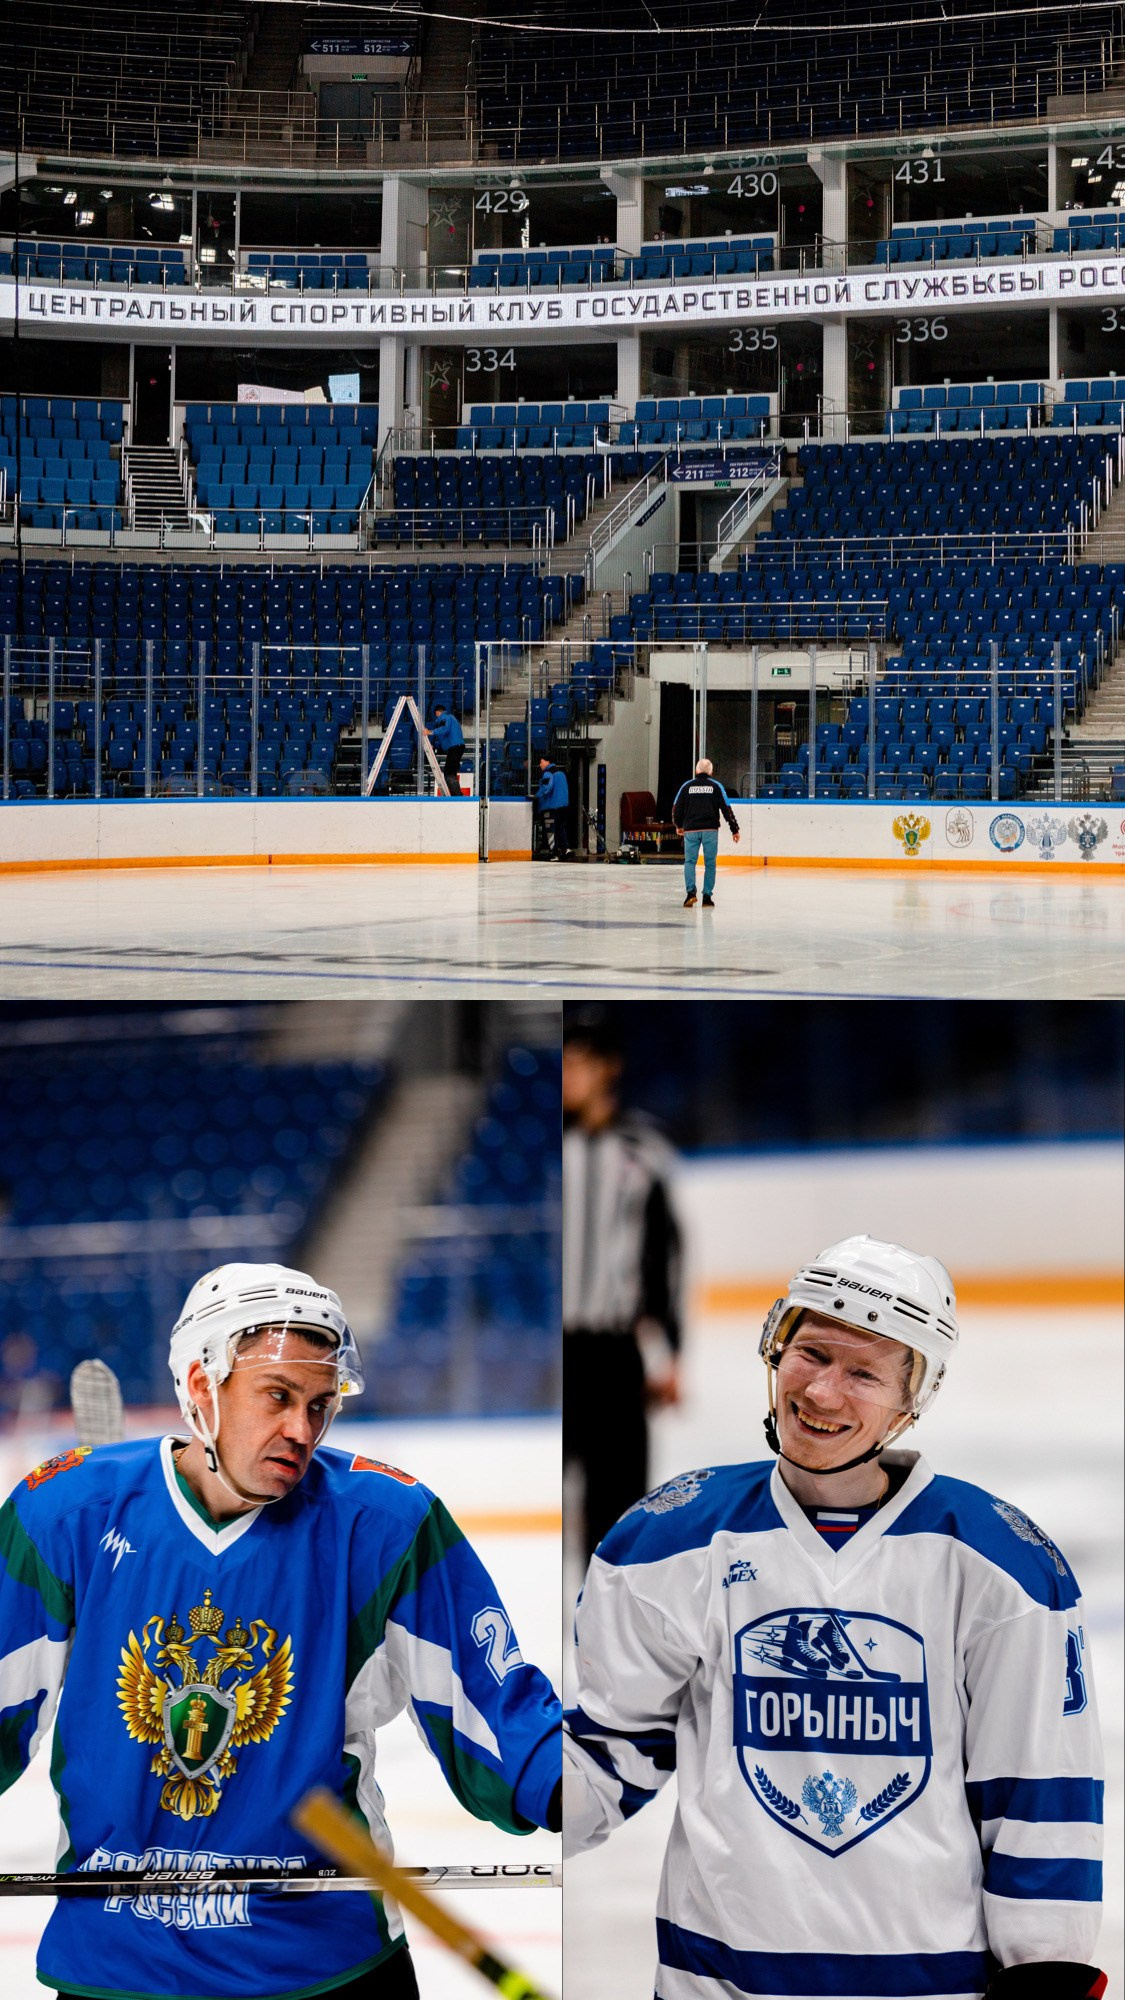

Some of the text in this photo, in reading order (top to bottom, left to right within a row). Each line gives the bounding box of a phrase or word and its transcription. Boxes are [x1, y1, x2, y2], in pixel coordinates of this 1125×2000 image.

[322, 44, 340, 53] 511
[364, 44, 382, 53] 512
[895, 158, 946, 184] 431
[727, 172, 778, 198] 430
[475, 190, 527, 213] 429
[29, 292, 257, 323] ЦЕНТРАЛЬНЫЙ
[270, 298, 475, 324] СПОРТИВНЫЙ
[488, 300, 563, 322] КЛУБ
[575, 278, 851, 318] ГОСУДАРСТВЕННОЙ
[1059, 265, 1125, 289] РОС
[728, 326, 778, 352] 335
[896, 316, 949, 343] 336
[466, 348, 517, 372] 334
[685, 470, 703, 479] 211
[729, 467, 749, 478] 212
[285, 1287, 328, 1300] BAUER
[837, 1277, 893, 1301] BAUER
[470, 1606, 527, 1687] 2
[745, 1689, 921, 1742] ГОРЫНЫЧ
[143, 1871, 216, 1881] BAUER
[318, 1869, 337, 1877] ZUB
